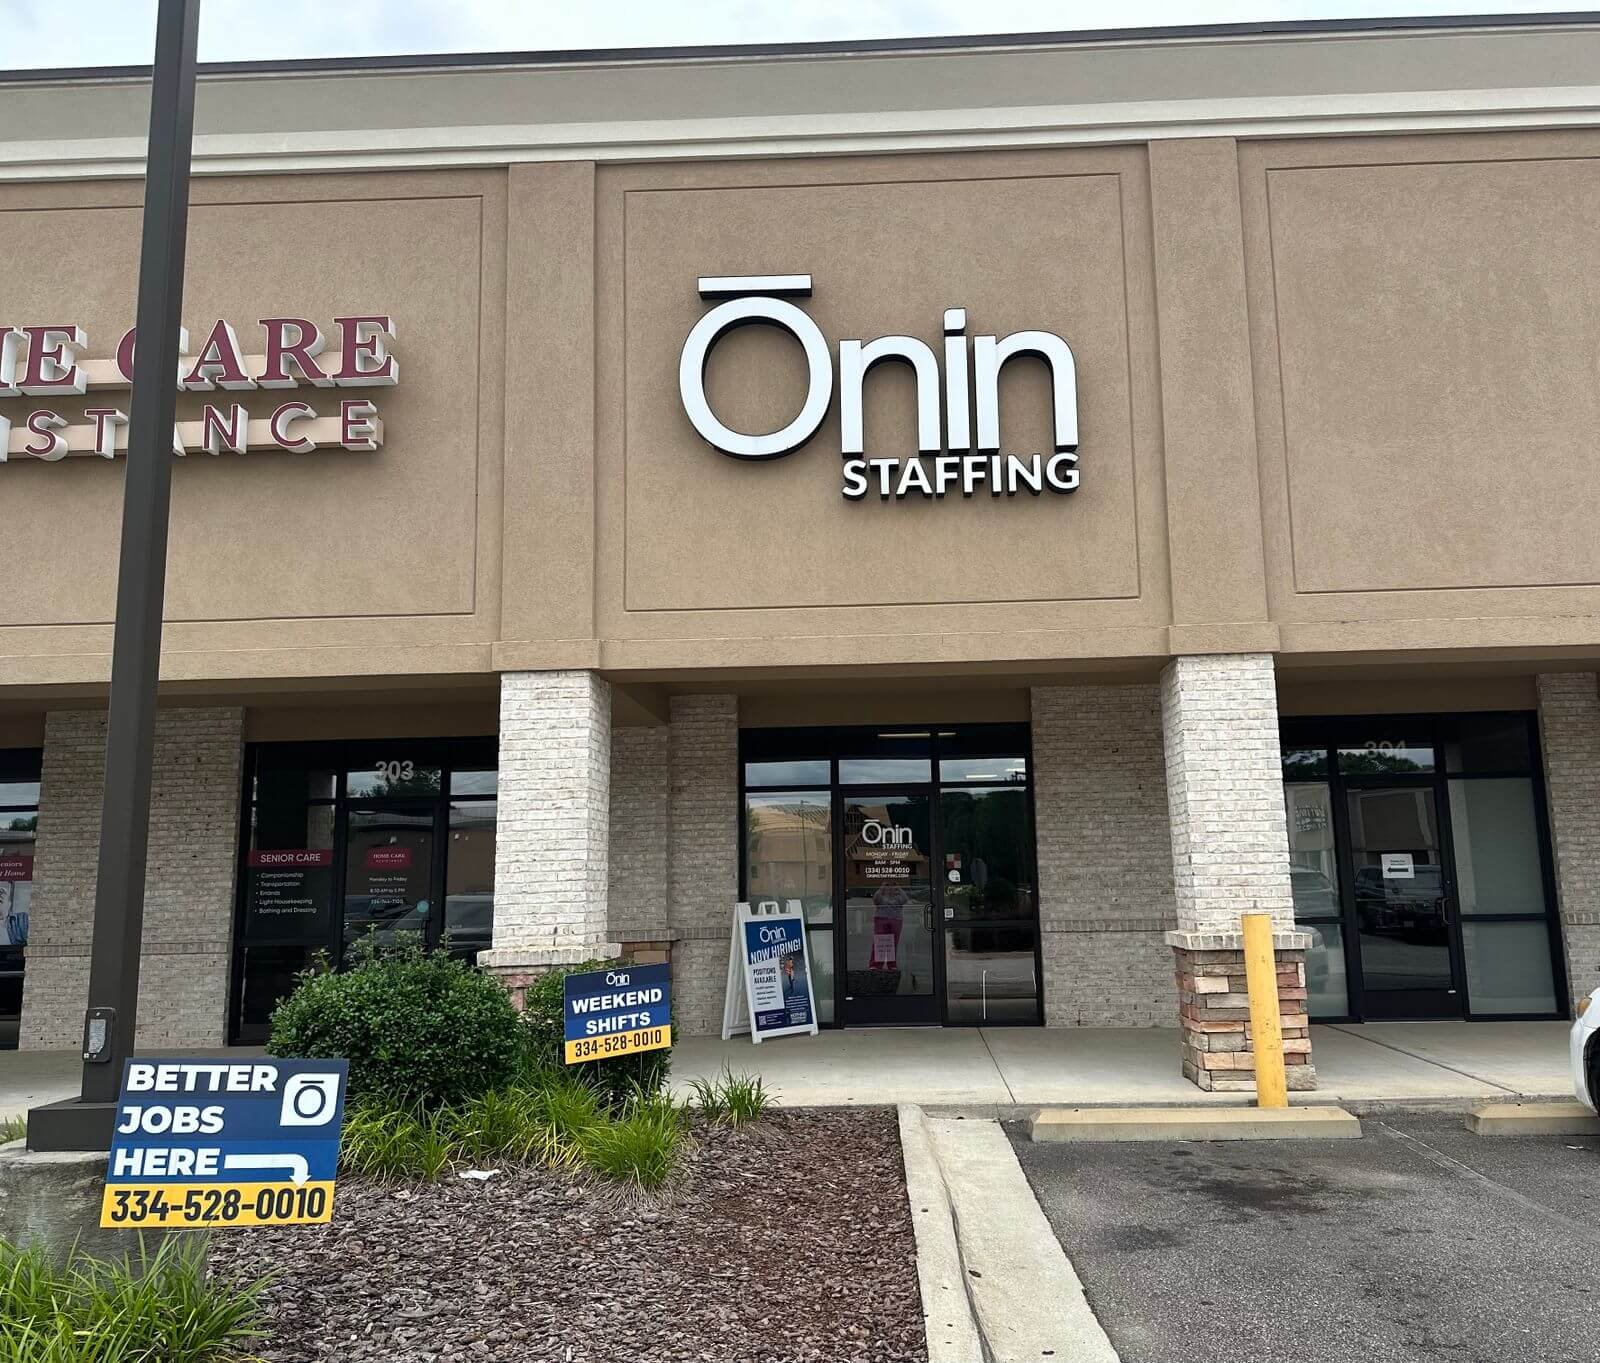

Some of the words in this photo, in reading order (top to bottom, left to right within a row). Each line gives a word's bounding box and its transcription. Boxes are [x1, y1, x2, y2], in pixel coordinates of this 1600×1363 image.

[0, 325, 80, 388] E
[842, 452, 1081, 498] STAFFING
[376, 760, 414, 780] 303
[260, 854, 294, 863] SENIOR
[296, 853, 321, 862] CARE
[750, 946, 770, 965] NOW
[771, 938, 801, 959] HIRING!
[752, 967, 776, 976] POSITIONS
[572, 988, 663, 1014] WEEKEND
[586, 1012, 651, 1035] SHIFTS
[575, 1029, 662, 1057] 334-528-0010
[126, 1064, 279, 1092] BETTER
[117, 1105, 225, 1134] JOBS
[113, 1148, 221, 1176] HERE
[111, 1186, 326, 1223] 334-528-0010
